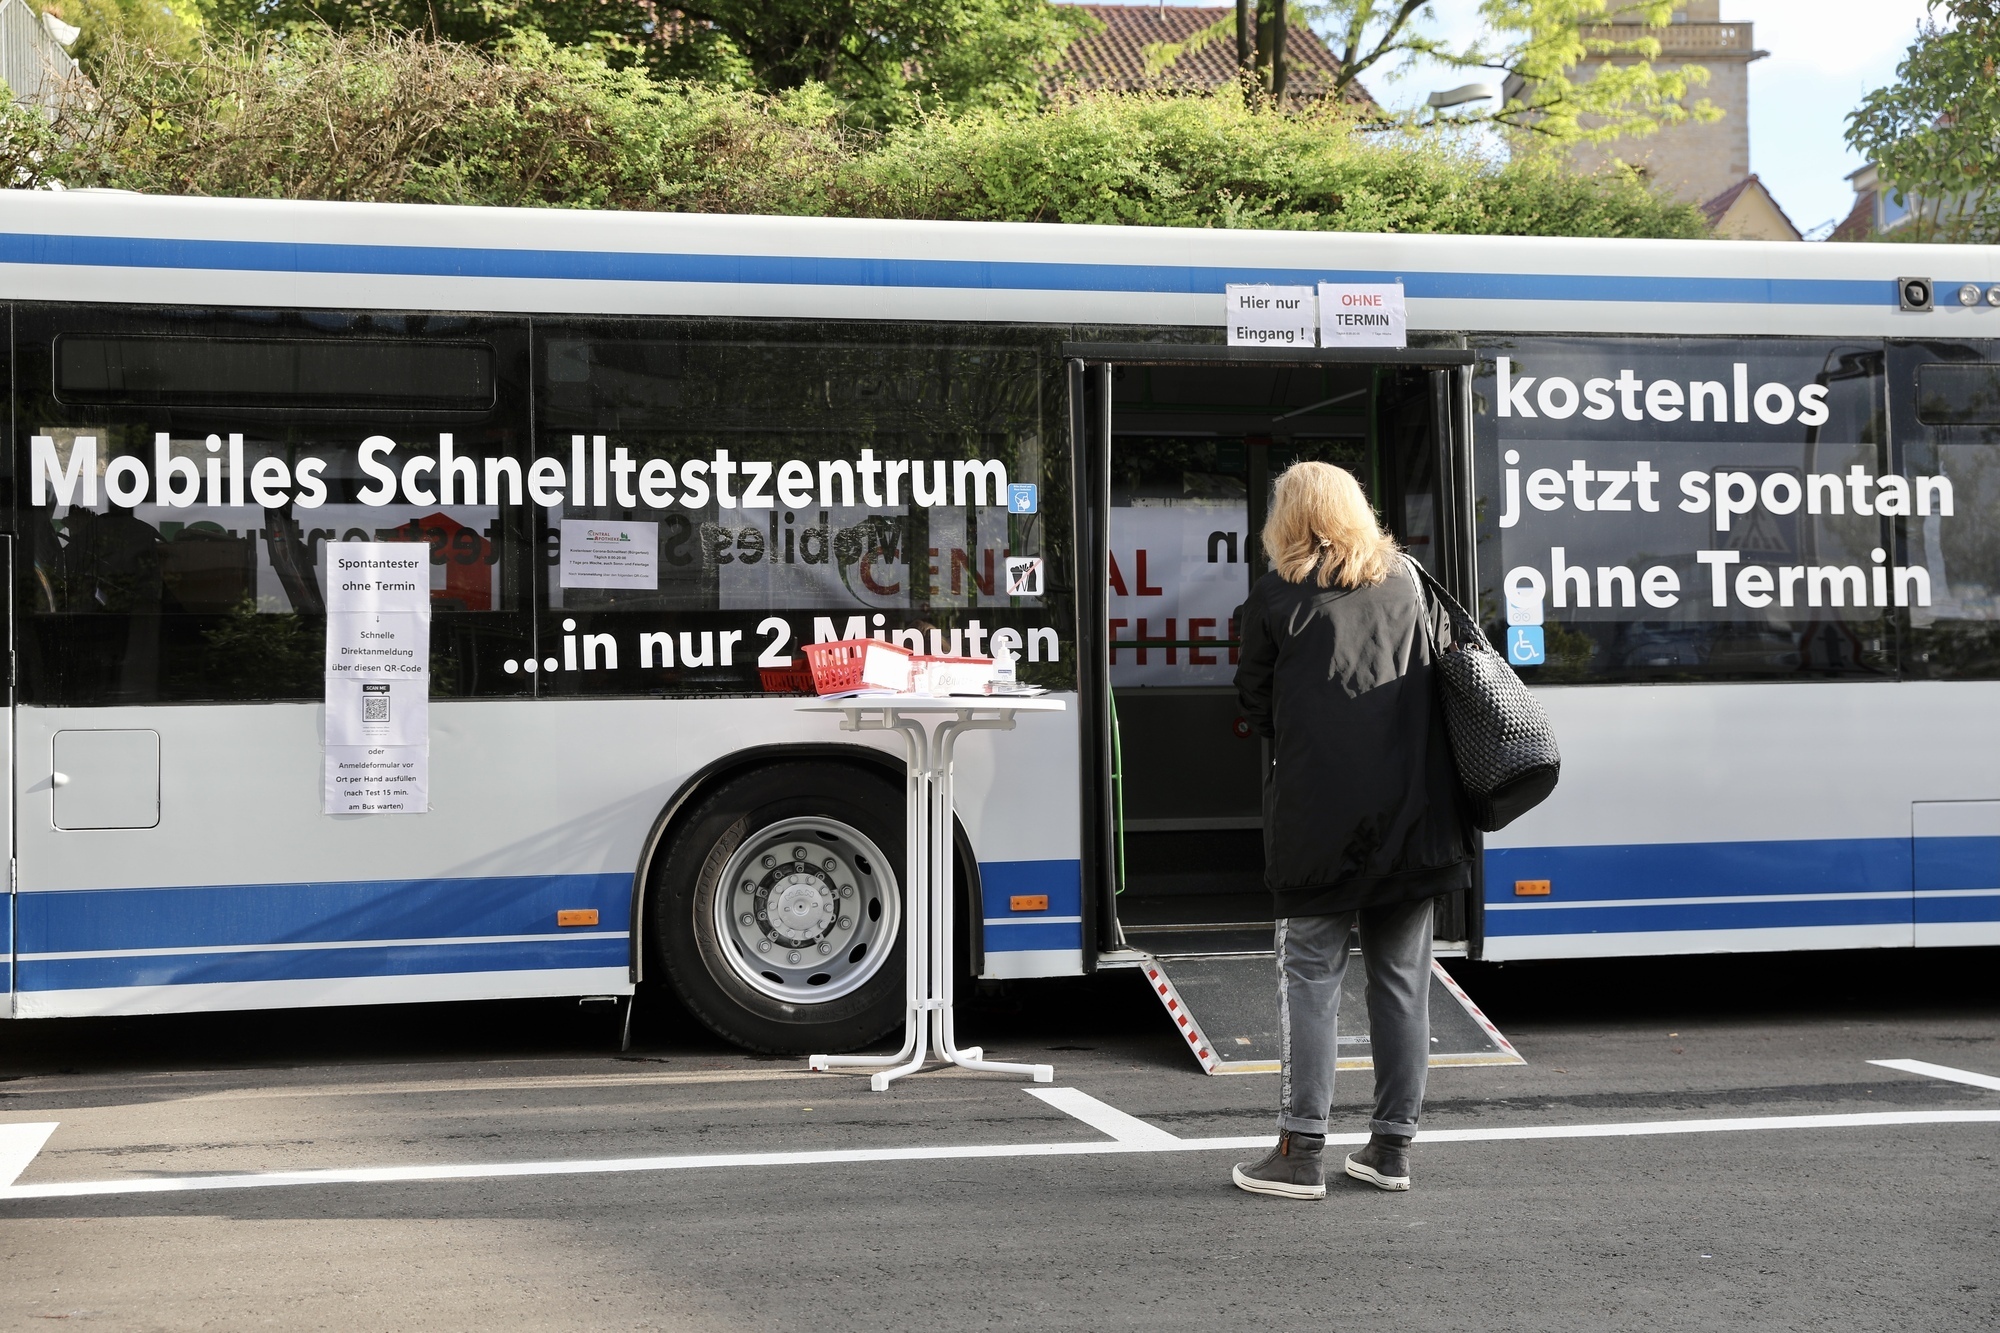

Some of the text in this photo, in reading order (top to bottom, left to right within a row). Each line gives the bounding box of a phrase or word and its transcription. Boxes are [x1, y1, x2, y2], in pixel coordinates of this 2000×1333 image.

[1240, 296, 1300, 309] Hier nur
[1341, 294, 1382, 307] OHNE
[1336, 314, 1389, 326] TERMIN
[1236, 326, 1305, 343] Eingang !
[1497, 357, 1829, 426] kostenlos
[31, 432, 1008, 508] Mobiles Schnelltestzentrum
[1499, 449, 1954, 531] jetzt spontan
[338, 558, 419, 570] Spontantester
[1504, 547, 1932, 608] ohne Termin
[342, 581, 416, 591] ohne Termin
[360, 631, 395, 640] Schnelle
[640, 629, 742, 668] nur
[756, 617, 792, 668] 2
[813, 613, 1059, 664] Minuten
[341, 647, 414, 657] Direktanmeldung
[332, 663, 422, 673] über diesen QR-Code
[343, 789, 363, 797] (nach
[393, 788, 409, 796] min.
[377, 803, 404, 811] warten)
[784, 889, 814, 901] MAN
